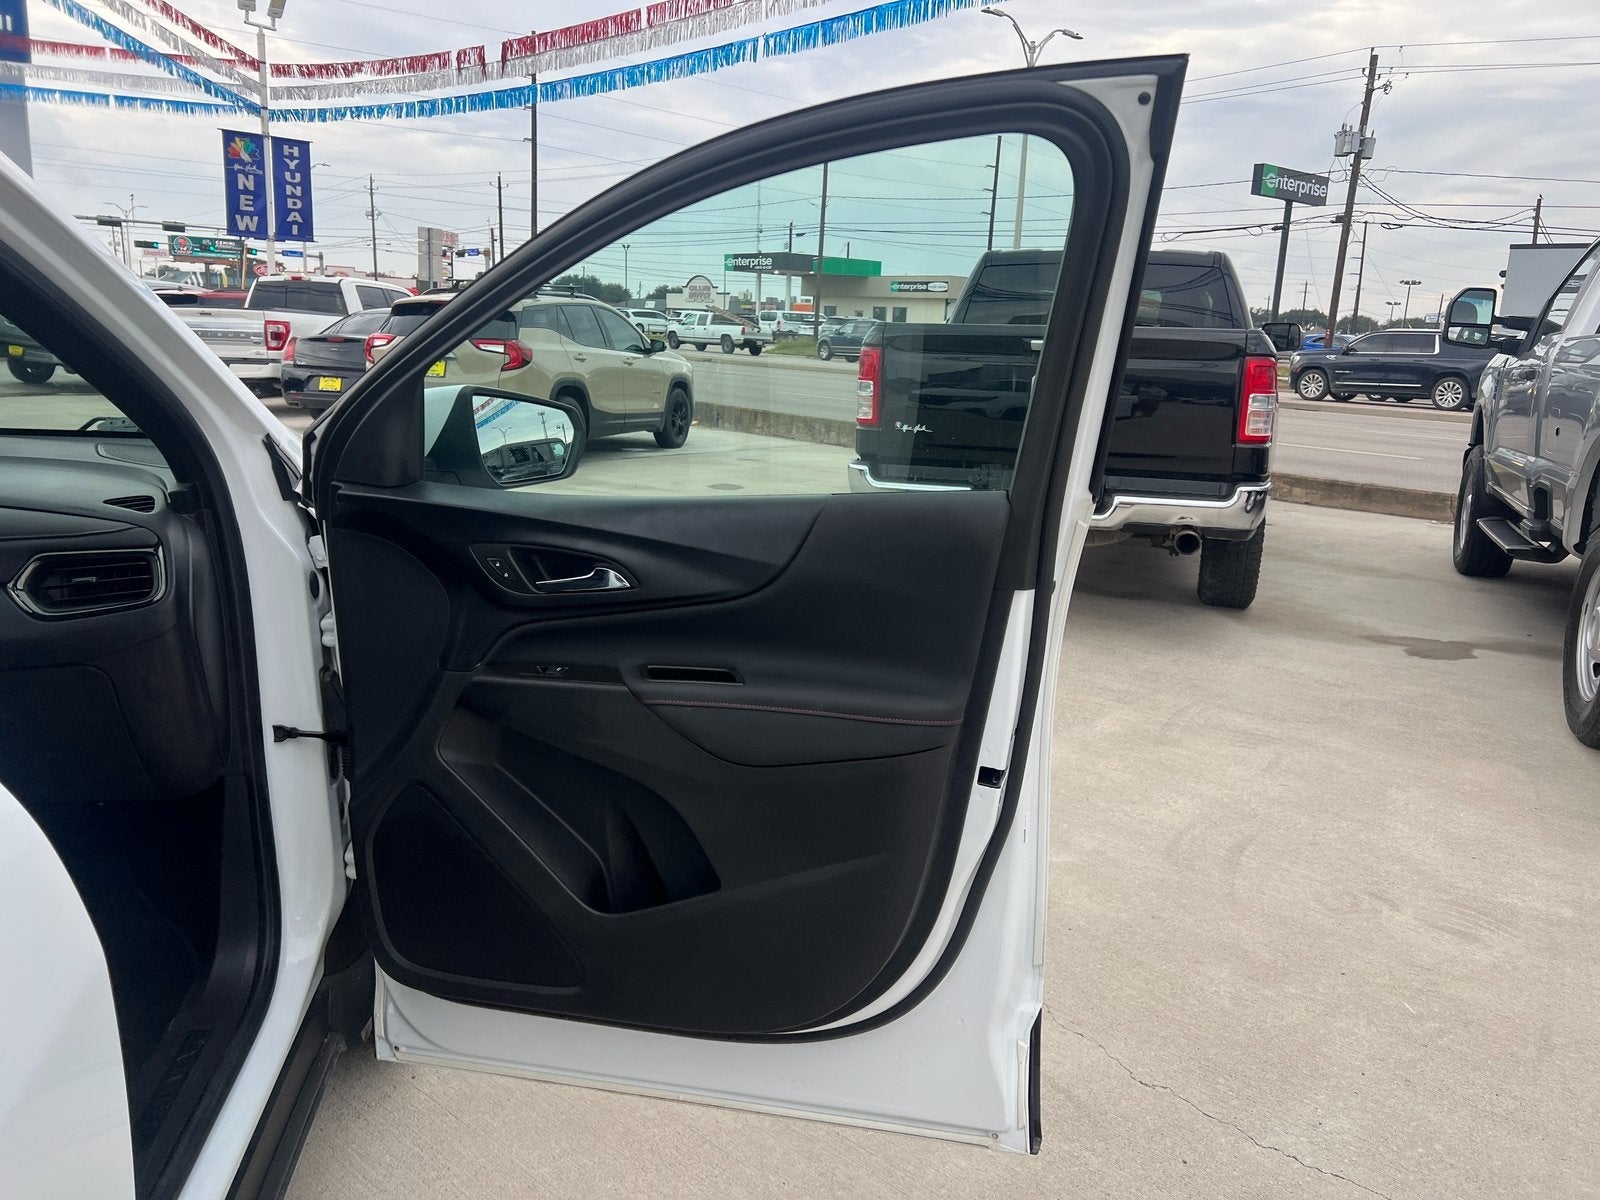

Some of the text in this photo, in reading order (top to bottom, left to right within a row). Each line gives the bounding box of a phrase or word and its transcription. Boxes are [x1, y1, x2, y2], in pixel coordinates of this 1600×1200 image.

[283, 144, 303, 236] HYUNDAI
[1263, 172, 1327, 197] enterprise
[235, 173, 259, 232] NEW
[725, 255, 773, 268] enterprise
[890, 282, 928, 292] enterprise
